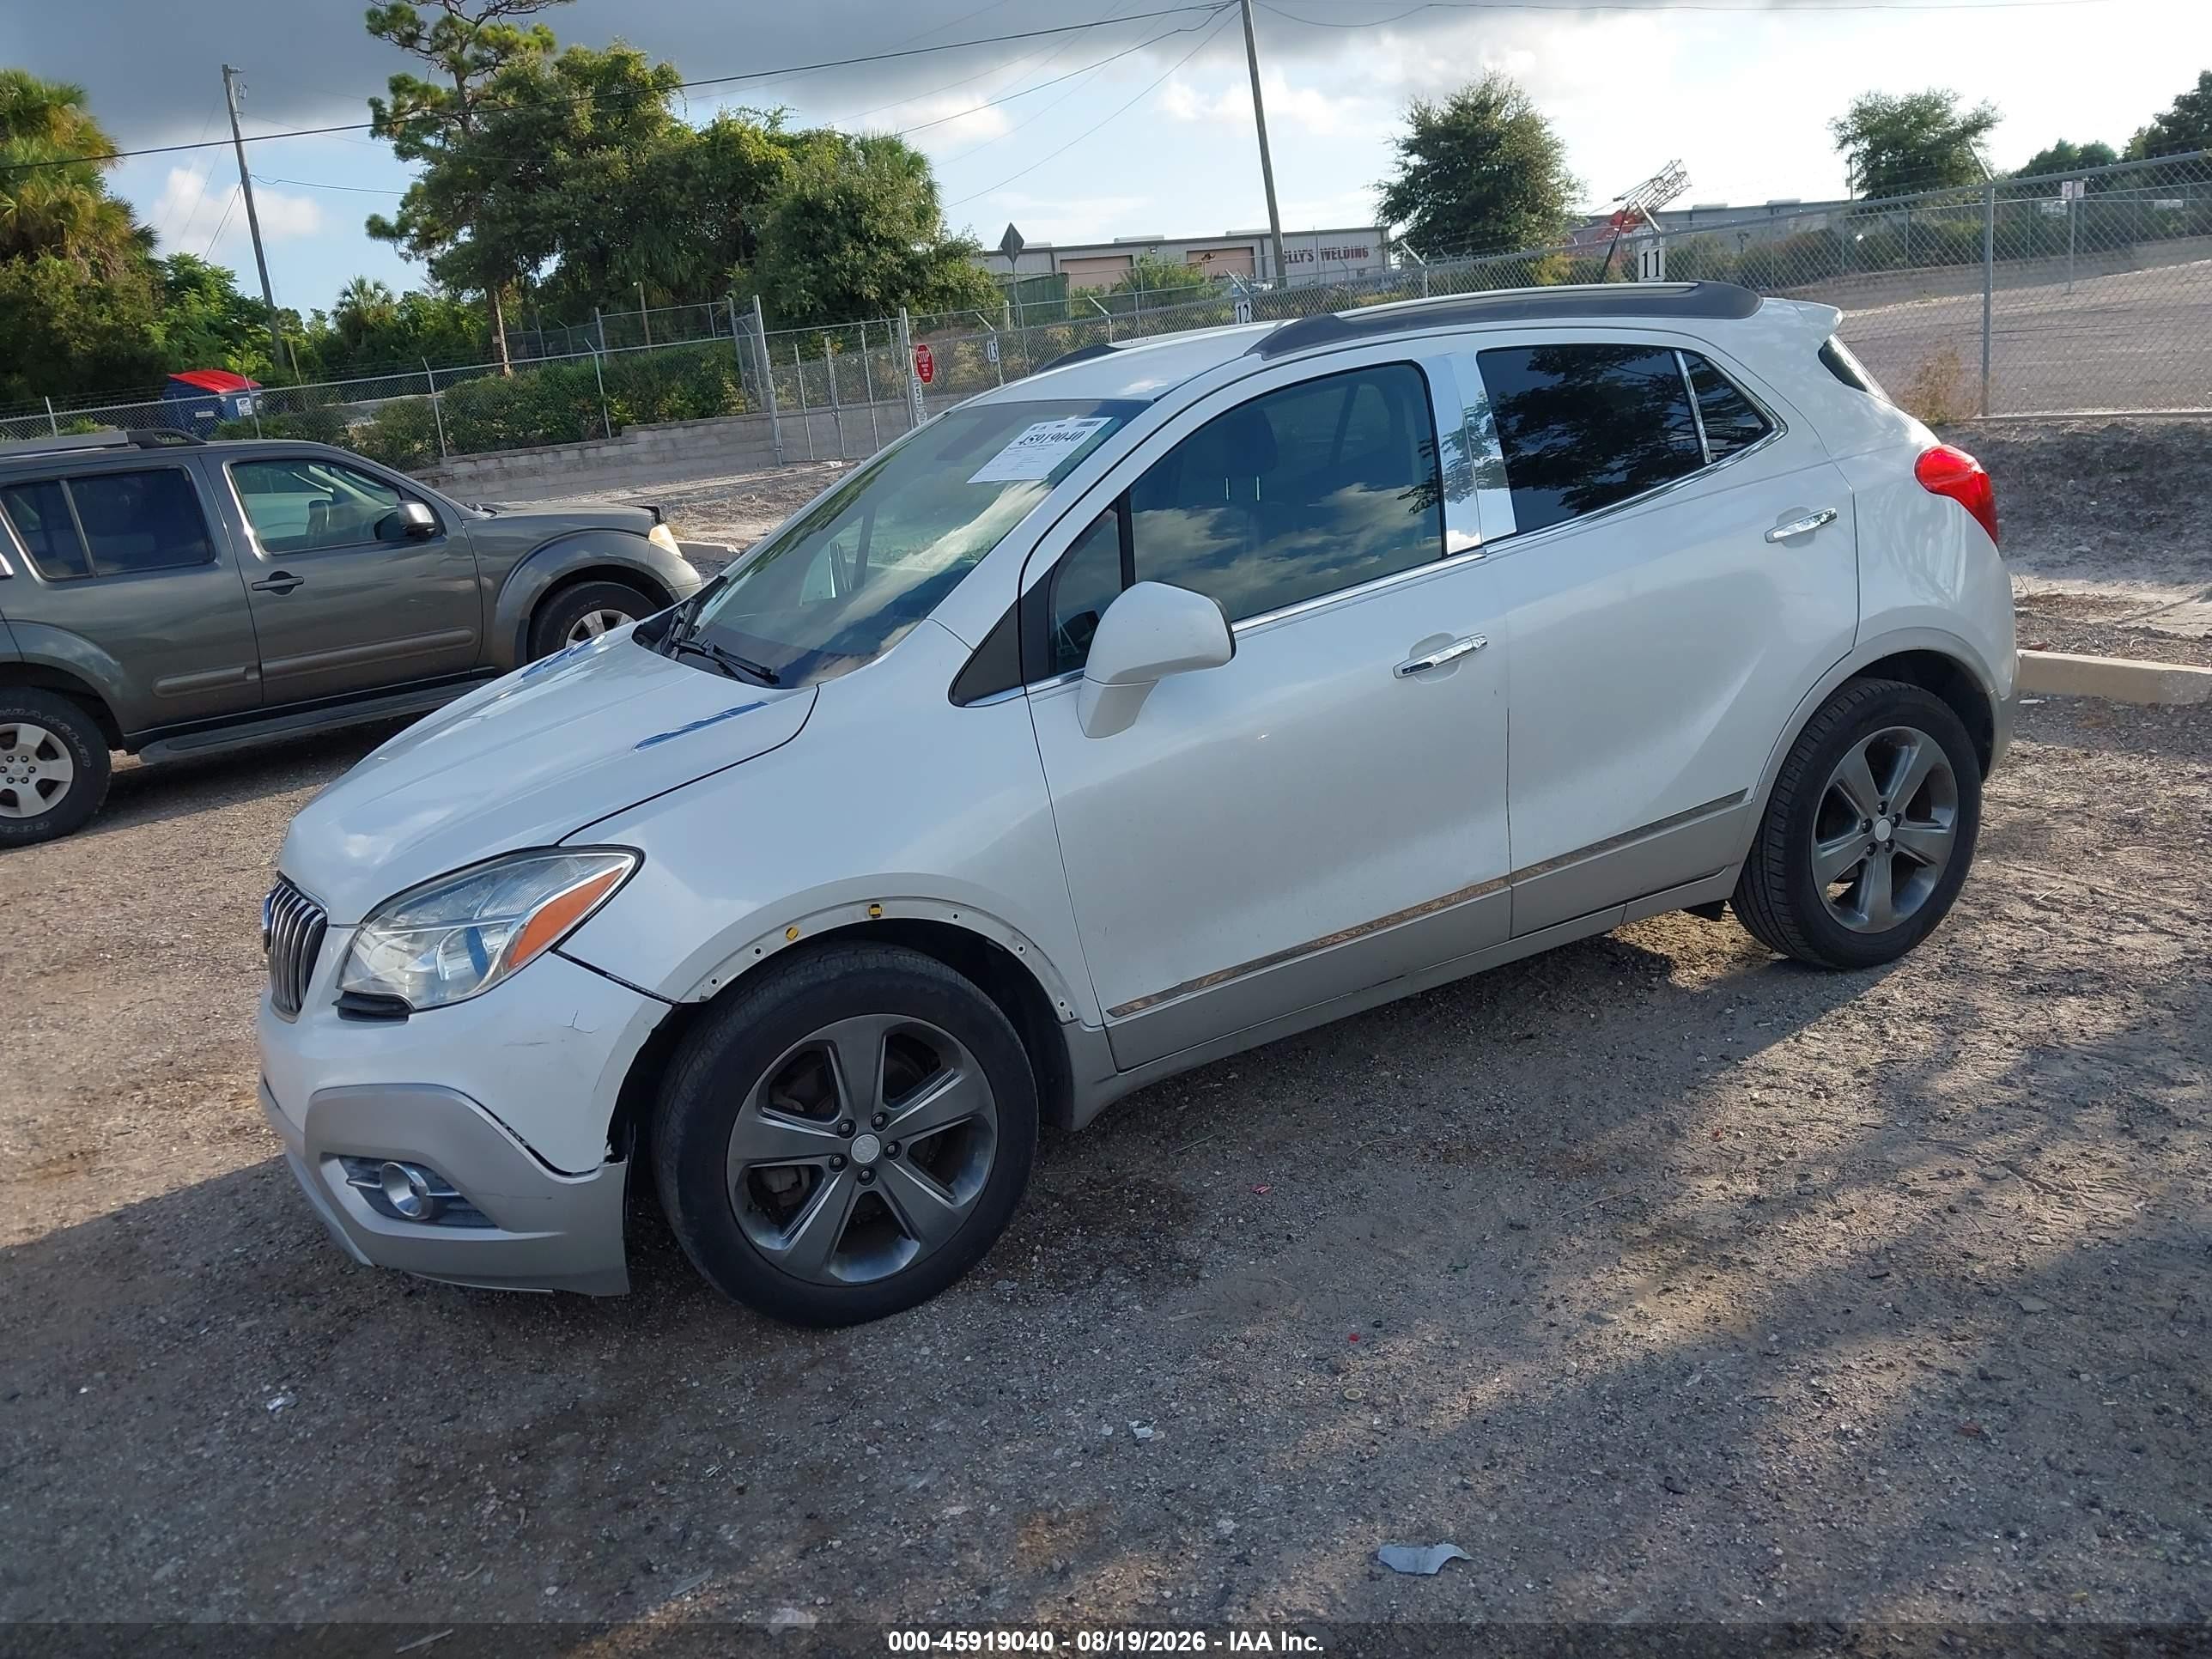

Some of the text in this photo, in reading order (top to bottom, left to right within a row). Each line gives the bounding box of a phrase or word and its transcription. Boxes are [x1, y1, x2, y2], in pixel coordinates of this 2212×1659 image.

[1284, 246, 1369, 264] ELLY'S WELDING
[1641, 249, 1660, 278] 11
[1237, 304, 1249, 324] 12
[917, 350, 929, 363] STOP
[988, 343, 997, 360] 13
[1017, 430, 1085, 446] 45919040
